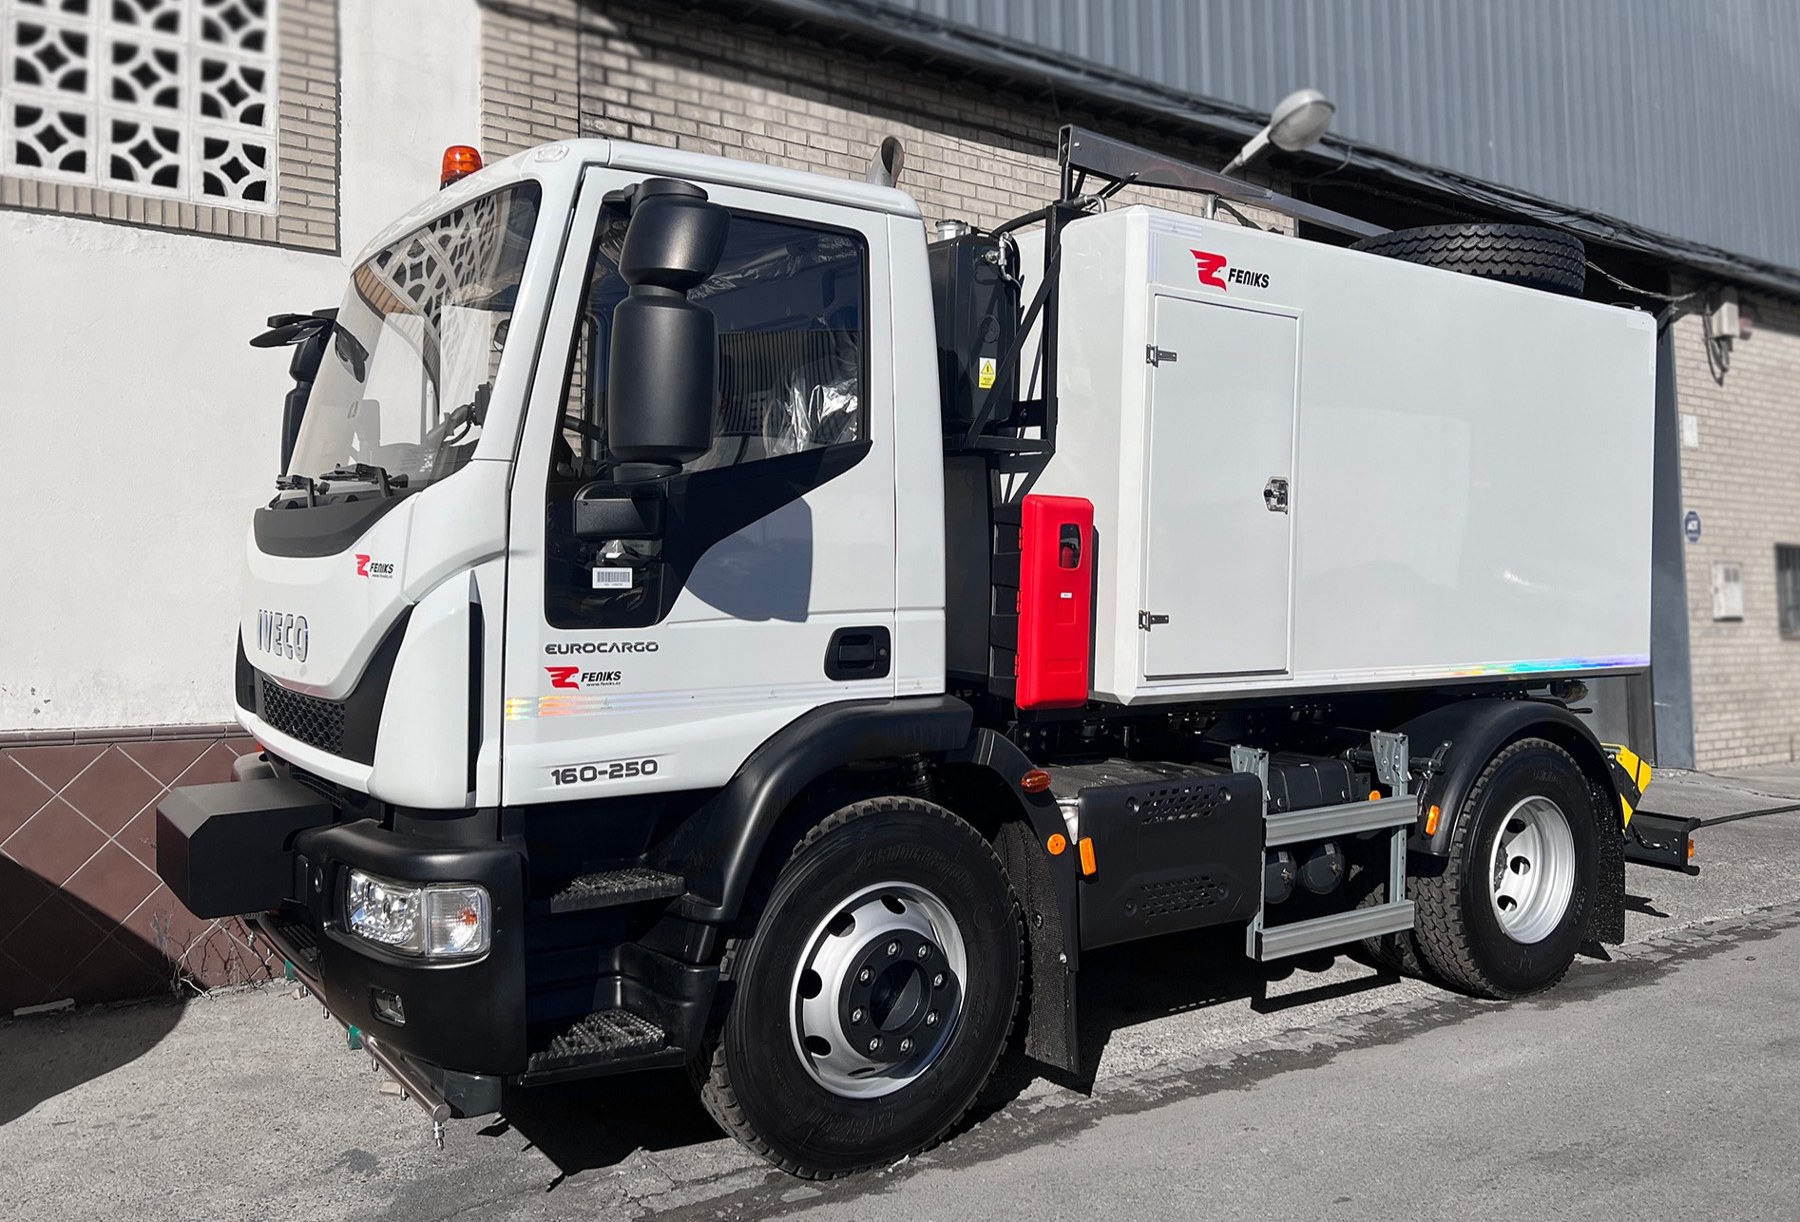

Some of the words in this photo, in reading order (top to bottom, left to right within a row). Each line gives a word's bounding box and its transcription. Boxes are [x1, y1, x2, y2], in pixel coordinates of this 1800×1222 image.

[1227, 267, 1270, 289] FENIKS
[370, 562, 394, 574] FENIKS
[256, 608, 309, 664] IVECO
[544, 641, 660, 655] EUROCARGO
[580, 670, 622, 683] FENIKS
[550, 759, 659, 786] 160-250
